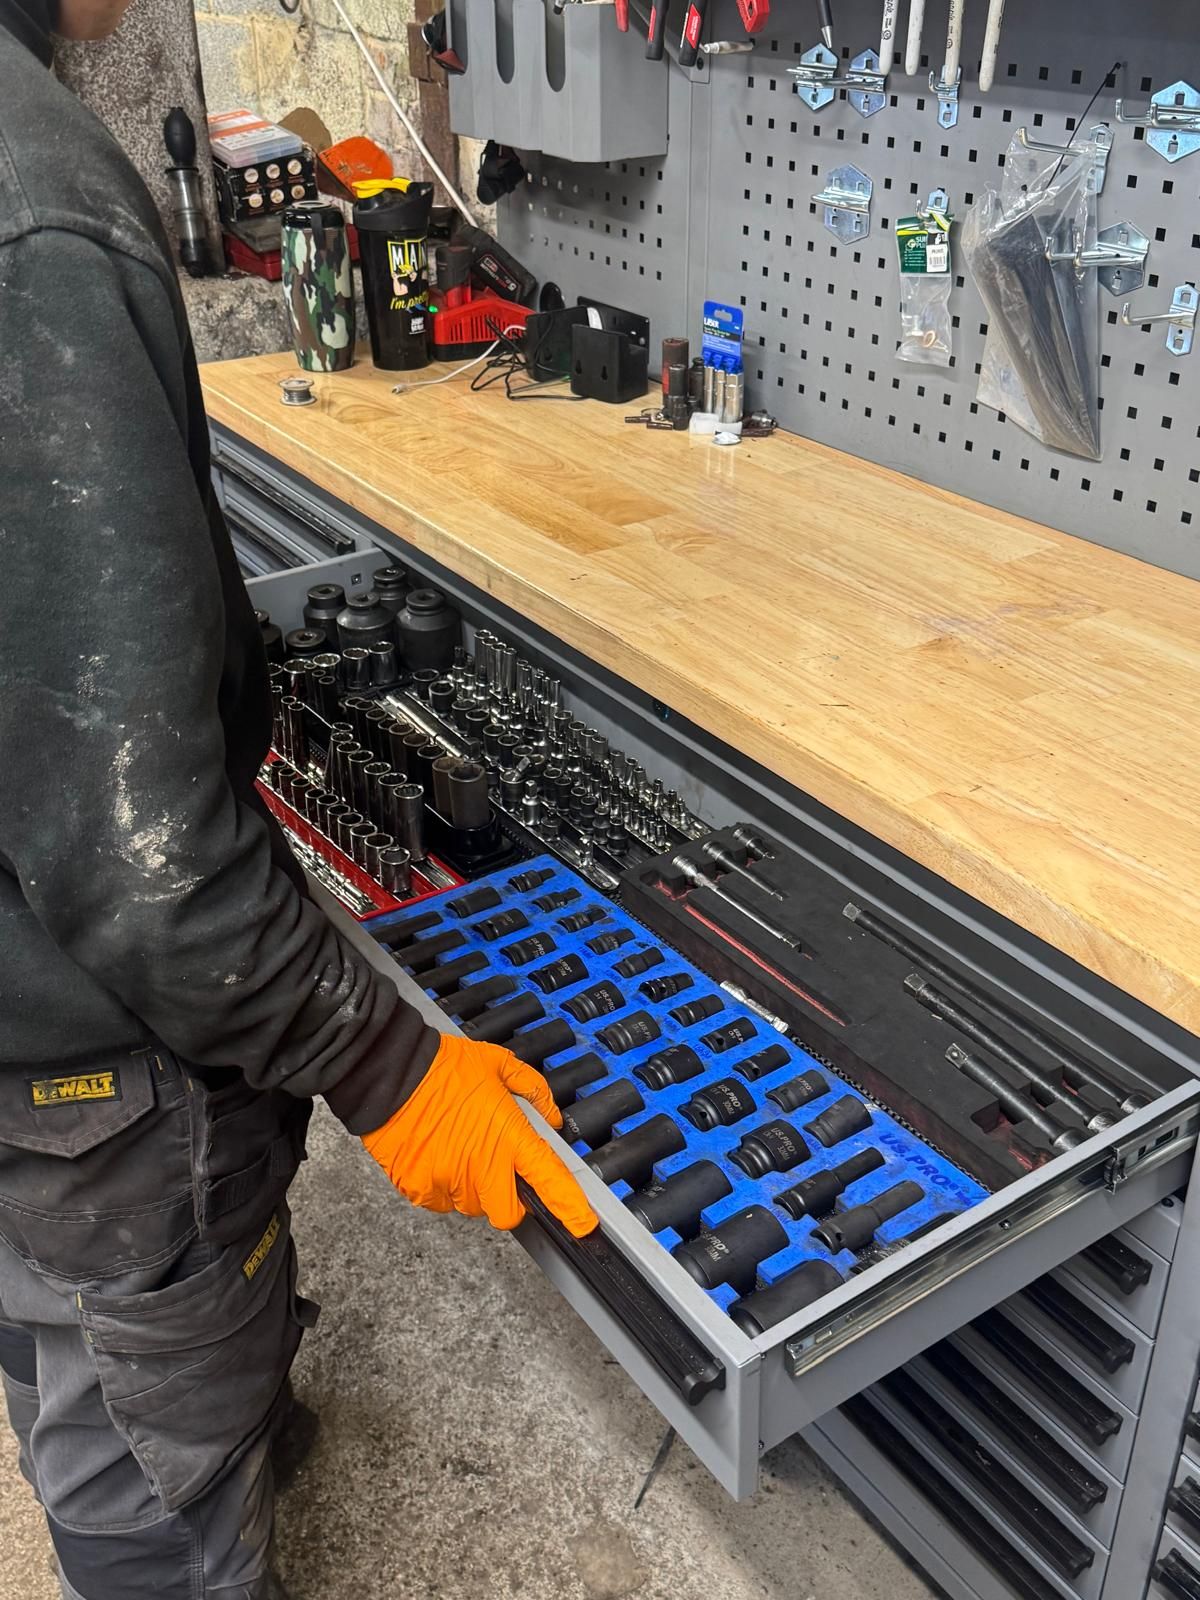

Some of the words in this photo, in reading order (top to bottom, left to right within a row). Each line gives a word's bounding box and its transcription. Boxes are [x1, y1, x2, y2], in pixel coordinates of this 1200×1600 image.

[390, 296, 407, 311] I'm
[718, 1083, 741, 1108] US.PRO
[770, 1127, 796, 1152] US.PRO
